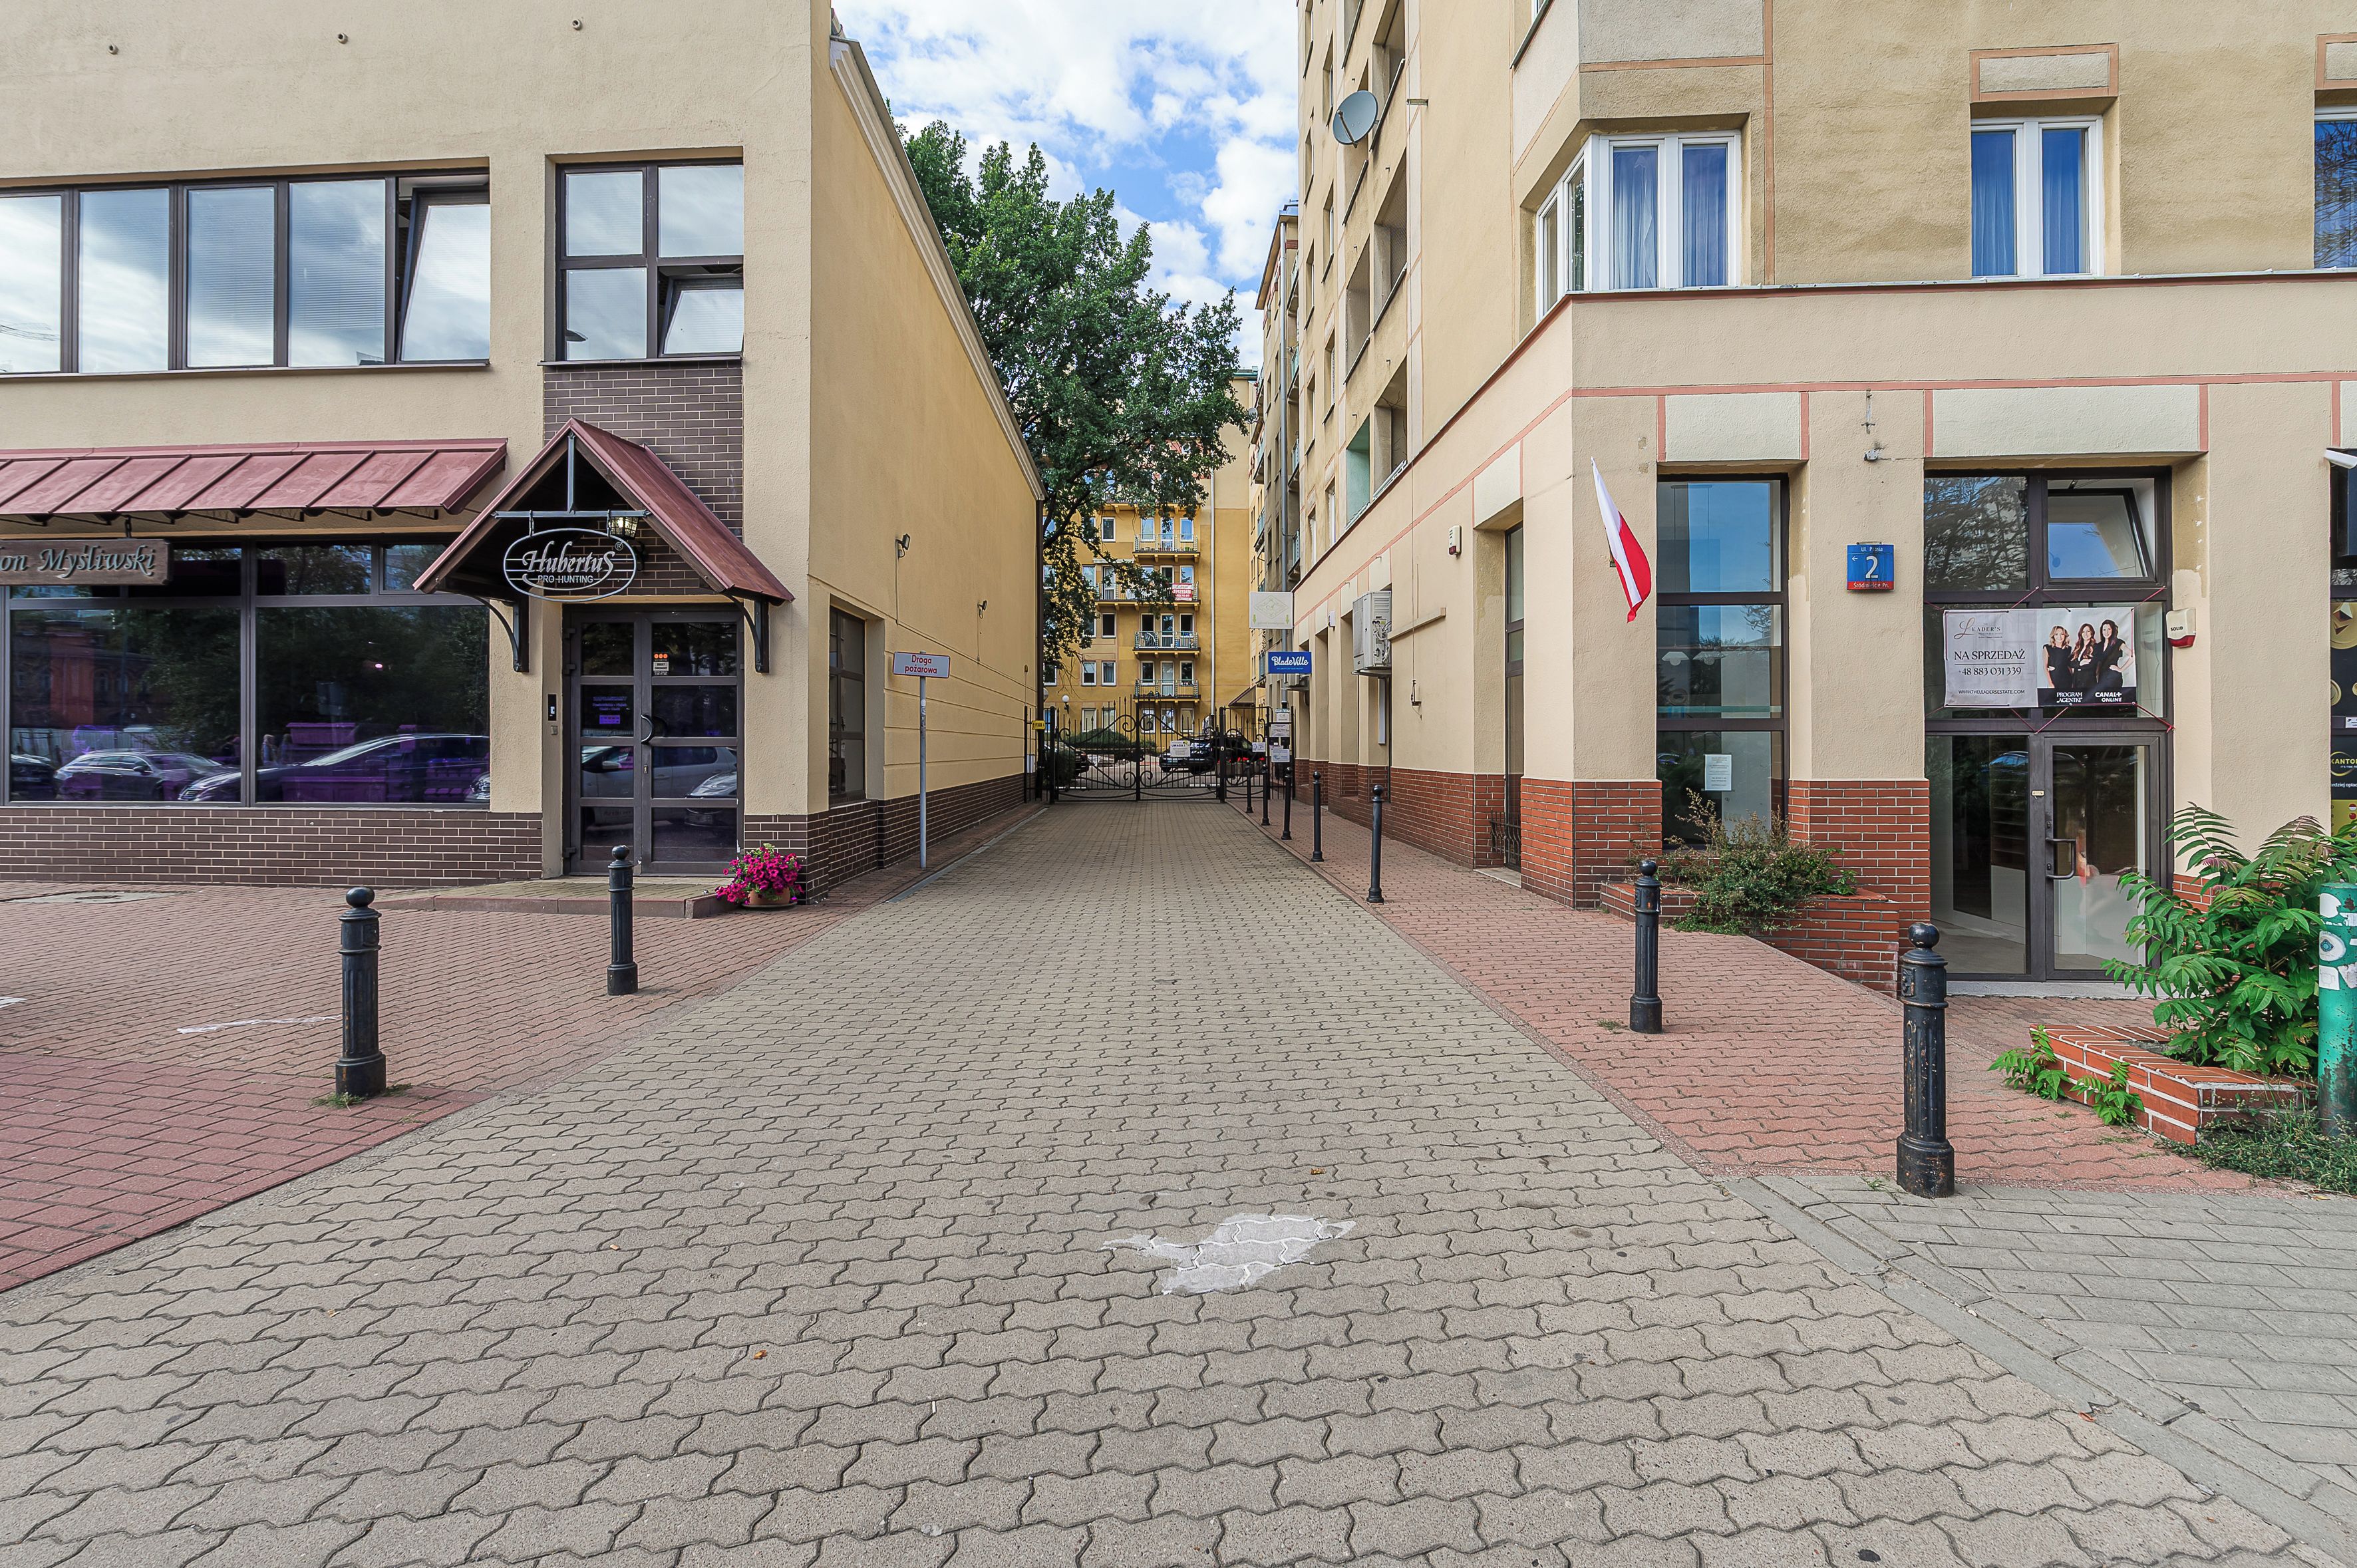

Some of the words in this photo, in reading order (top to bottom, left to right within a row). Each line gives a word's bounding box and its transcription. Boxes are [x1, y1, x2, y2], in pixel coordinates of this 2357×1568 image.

[38, 545, 156, 578] Myśliwski
[1865, 555, 1879, 579] 2
[538, 575, 555, 583] PRO
[557, 575, 593, 583] HUNTING
[1955, 651, 1970, 661] NA
[1971, 648, 2026, 661] SPRZEDAŻ
[911, 655, 932, 666] Droga
[1271, 656, 1309, 667] BladeVille
[905, 665, 937, 674] pożarowa
[1973, 667, 1988, 677] 883
[1990, 667, 2004, 676] 031
[2006, 667, 2022, 677] 339
